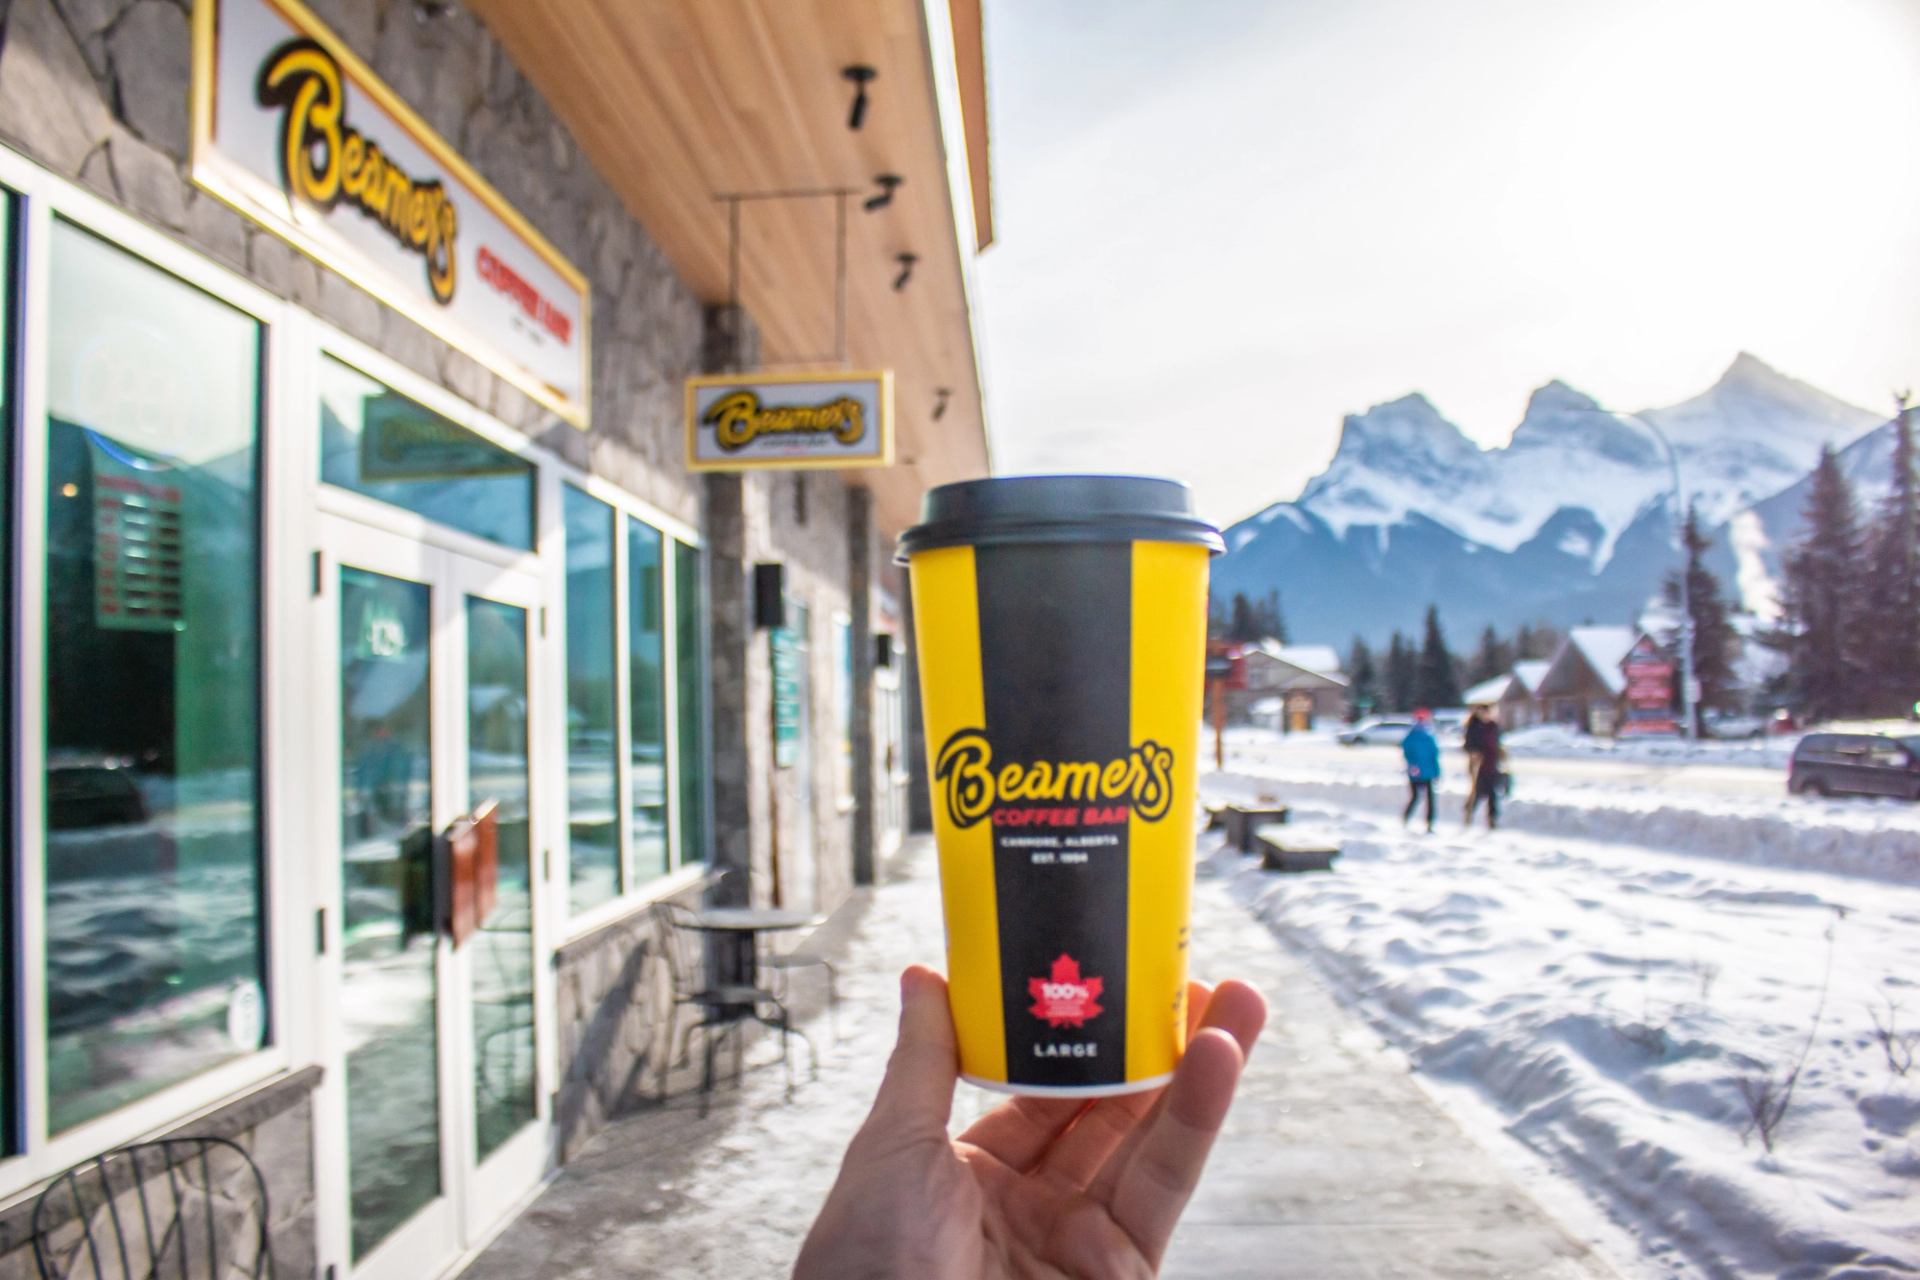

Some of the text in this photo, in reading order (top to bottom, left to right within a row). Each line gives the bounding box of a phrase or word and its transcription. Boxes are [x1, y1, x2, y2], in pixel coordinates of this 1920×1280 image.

[257, 38, 458, 306] Beamer's
[935, 727, 1174, 829] Beamer's
[992, 806, 1128, 826] COFFEE BAR
[1041, 983, 1090, 1000] 100%
[1032, 1042, 1098, 1058] LARGE
